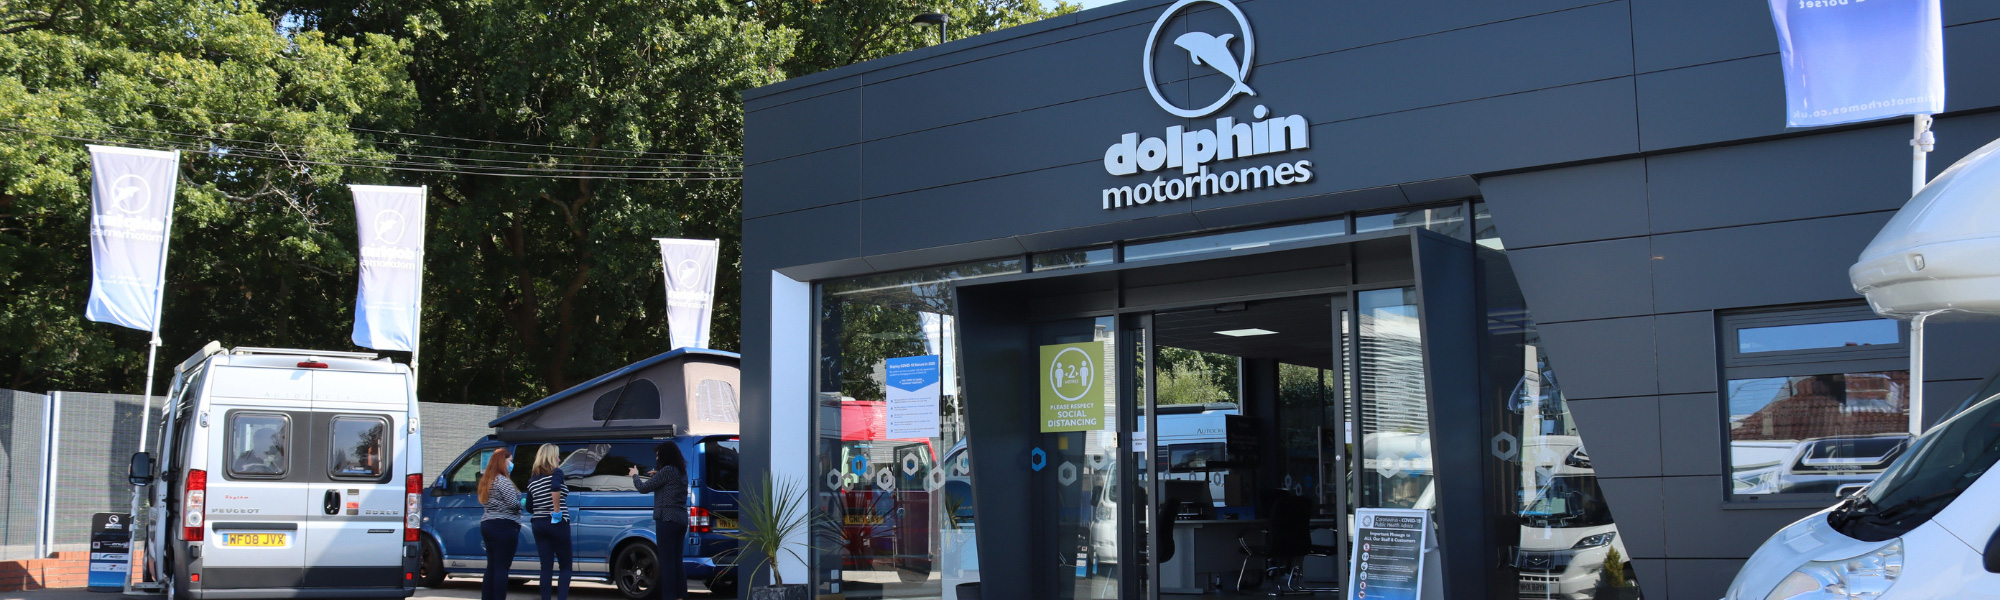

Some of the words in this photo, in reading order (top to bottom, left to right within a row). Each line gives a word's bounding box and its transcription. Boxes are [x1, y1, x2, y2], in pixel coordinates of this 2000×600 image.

[1104, 104, 1310, 176] dolphin
[1102, 159, 1313, 210] motorhomes
[1067, 364, 1076, 379] 2
[1057, 410, 1087, 418] SOCIAL
[1047, 418, 1097, 428] DISTANCING
[229, 534, 259, 545] WF08
[262, 534, 285, 545] JVX
